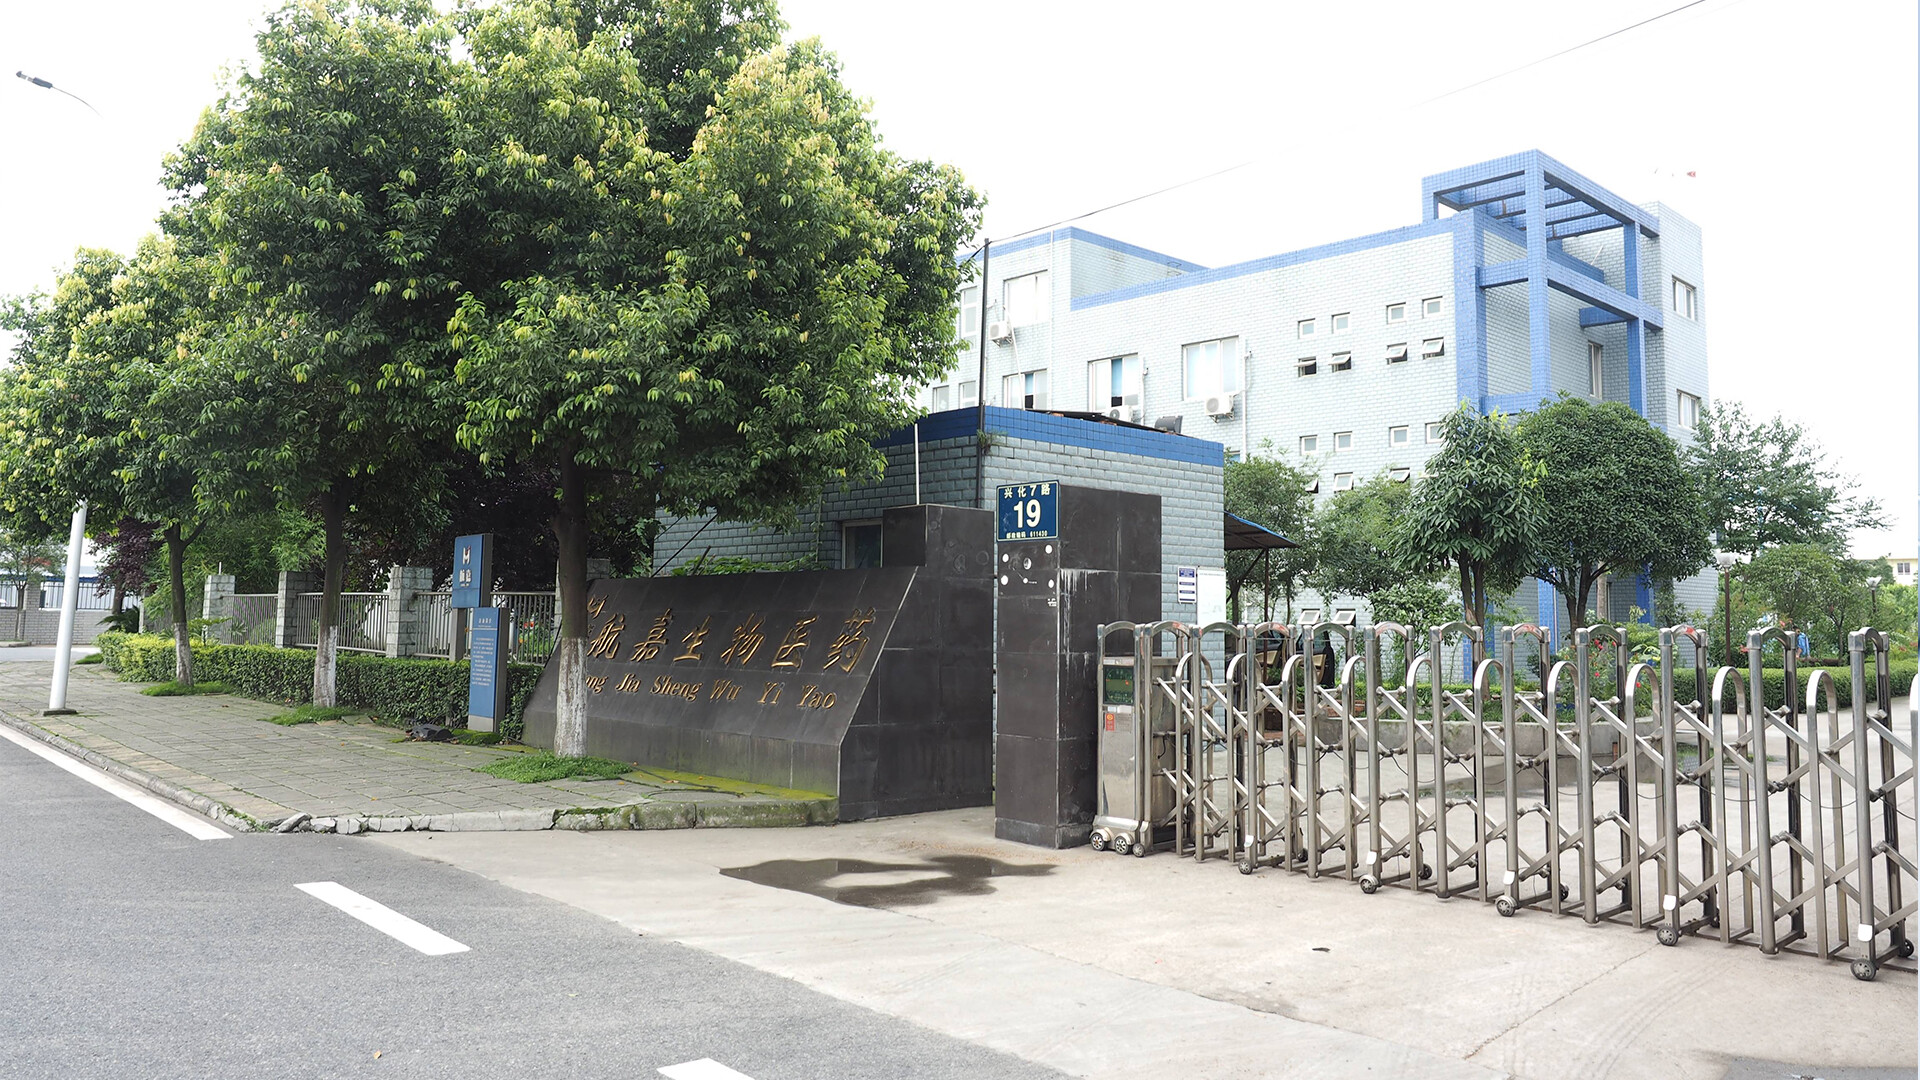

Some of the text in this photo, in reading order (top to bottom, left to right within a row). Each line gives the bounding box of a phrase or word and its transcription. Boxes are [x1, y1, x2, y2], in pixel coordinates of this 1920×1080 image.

[1004, 484, 1050, 499] 兴化7路
[1013, 499, 1041, 528] 19
[587, 607, 876, 673] 航嘉生物医药
[586, 673, 837, 709] ng Jia Sheng Wu Yi Yao
